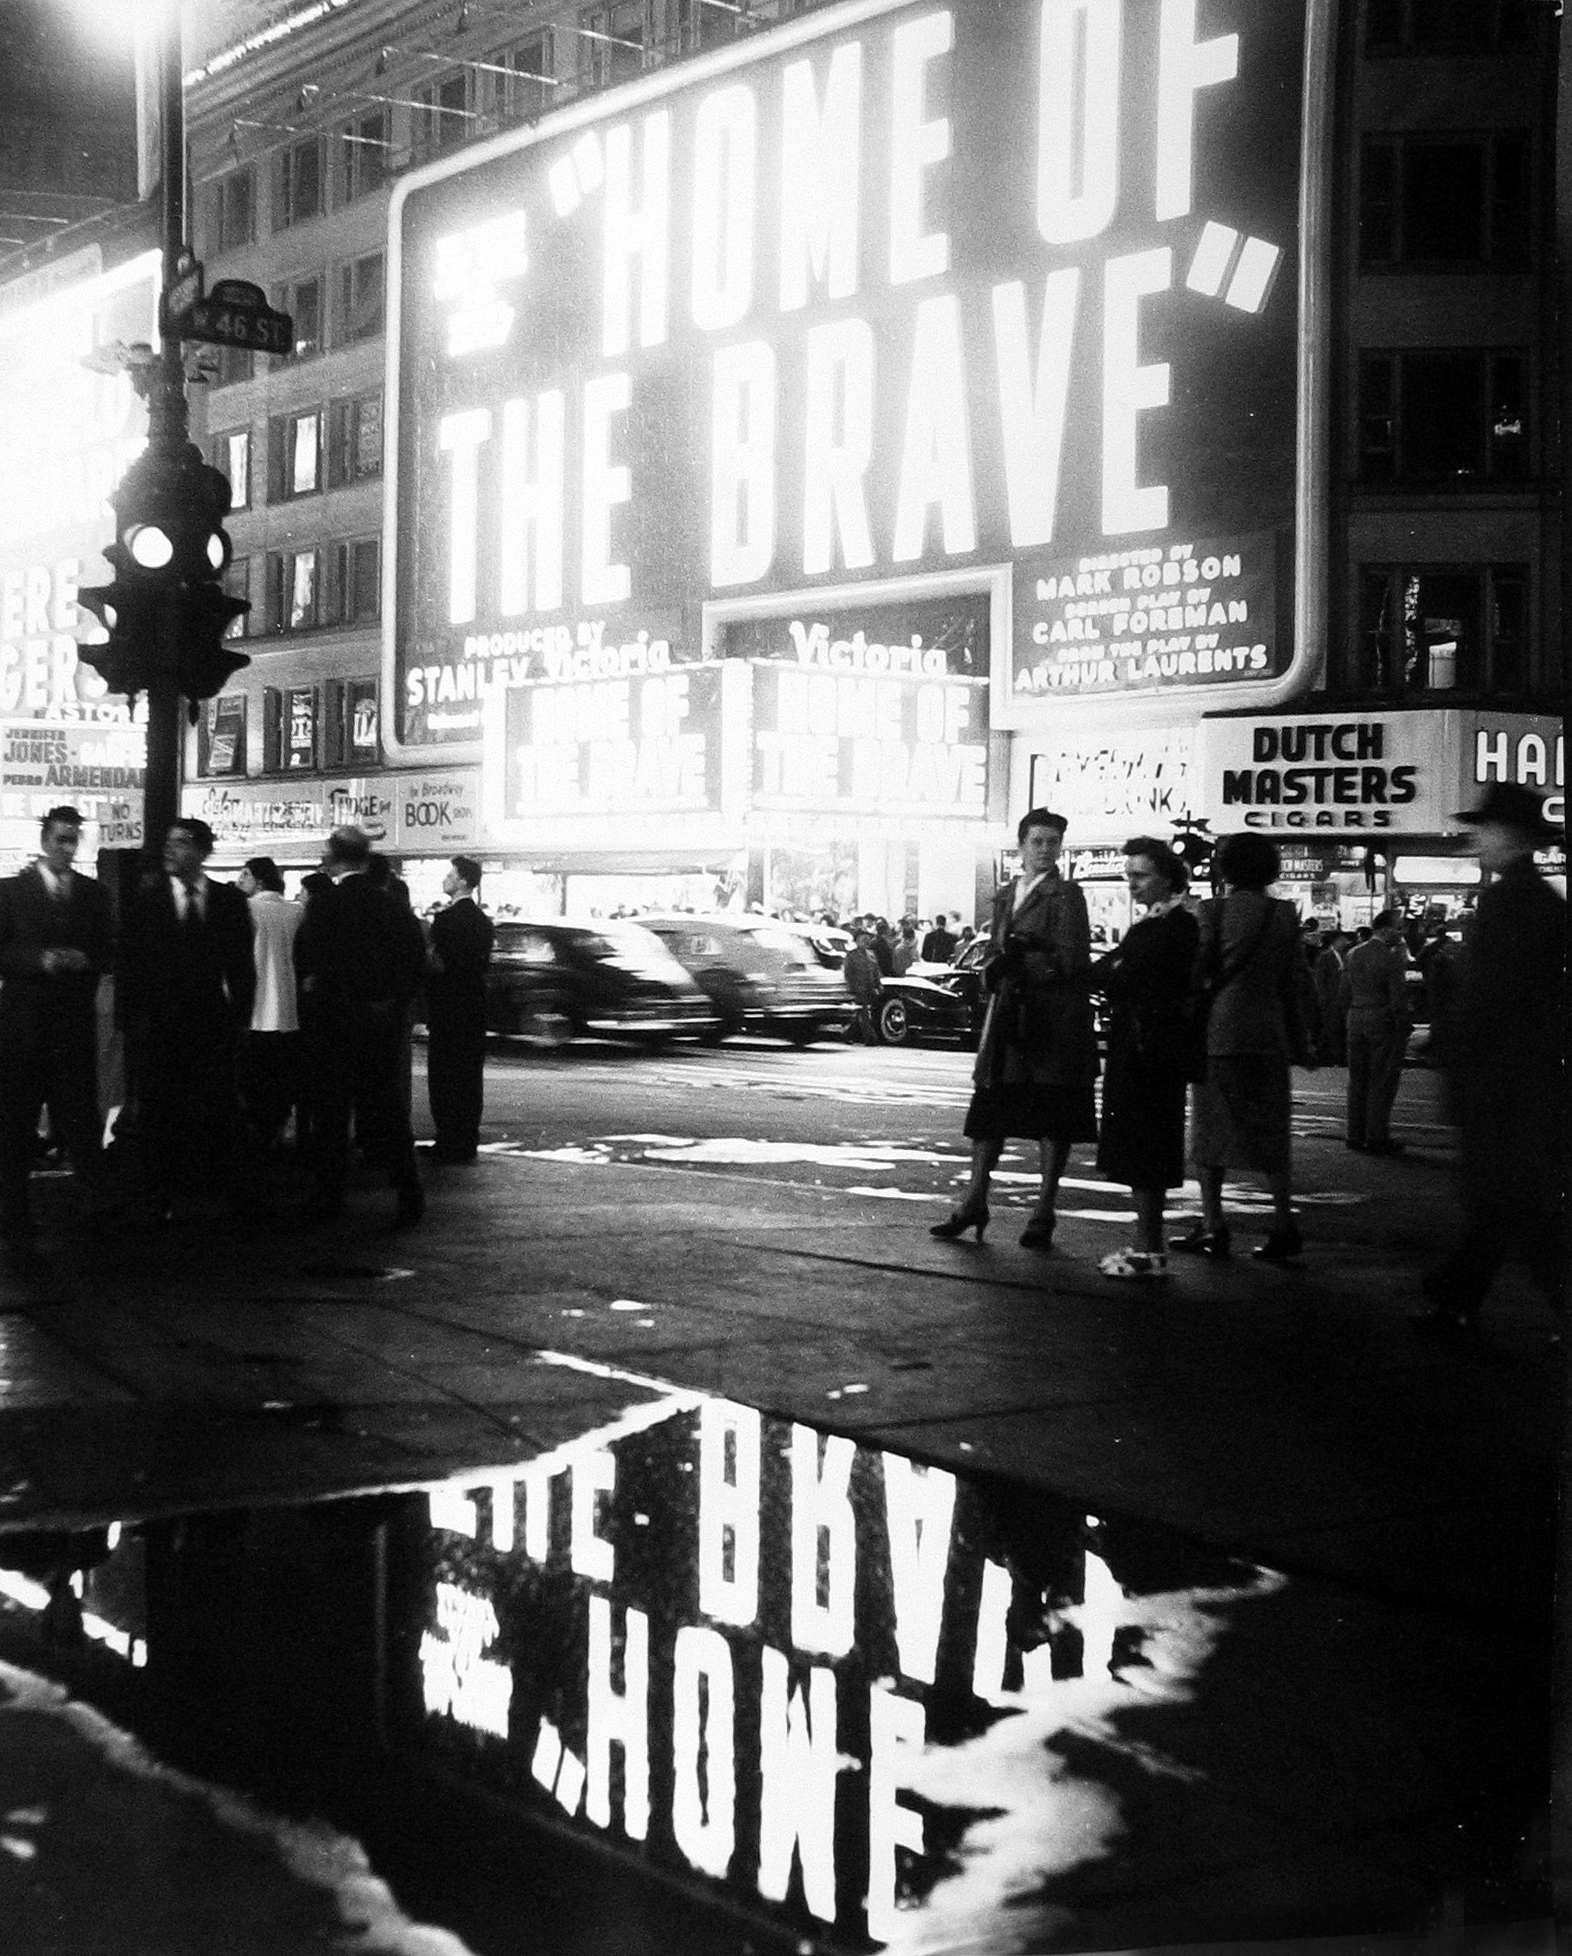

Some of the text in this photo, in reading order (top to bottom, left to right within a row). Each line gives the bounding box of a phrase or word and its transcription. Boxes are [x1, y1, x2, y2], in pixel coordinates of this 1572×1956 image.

[438, 371, 632, 625] THE
[1078, 543, 1194, 574] DIRECTED BY
[1035, 553, 1242, 602] MARK ROBSON
[1135, 590, 1182, 611] PLAY
[1186, 586, 1212, 606] BY
[1032, 599, 1249, 646] CARL FOREMAN
[463, 625, 573, 660] PRODUCED
[542, 629, 671, 684] Victoria
[789, 620, 948, 676] Victoria
[1146, 635, 1192, 656] PLAY
[1195, 632, 1220, 651] BY
[406, 655, 531, 707] STANLEY
[1012, 642, 1269, 692] ARTHUR LAURENTS
[3, 740, 69, 764] JONES
[1252, 721, 1385, 764] DUTCH
[3, 773, 43, 787] PEDRO
[1222, 765, 1418, 806] MASTERS
[111, 803, 131, 820] NO
[405, 801, 452, 828] BOOK
[1243, 811, 1393, 828] CIGARS
[99, 822, 143, 843] TURNS
